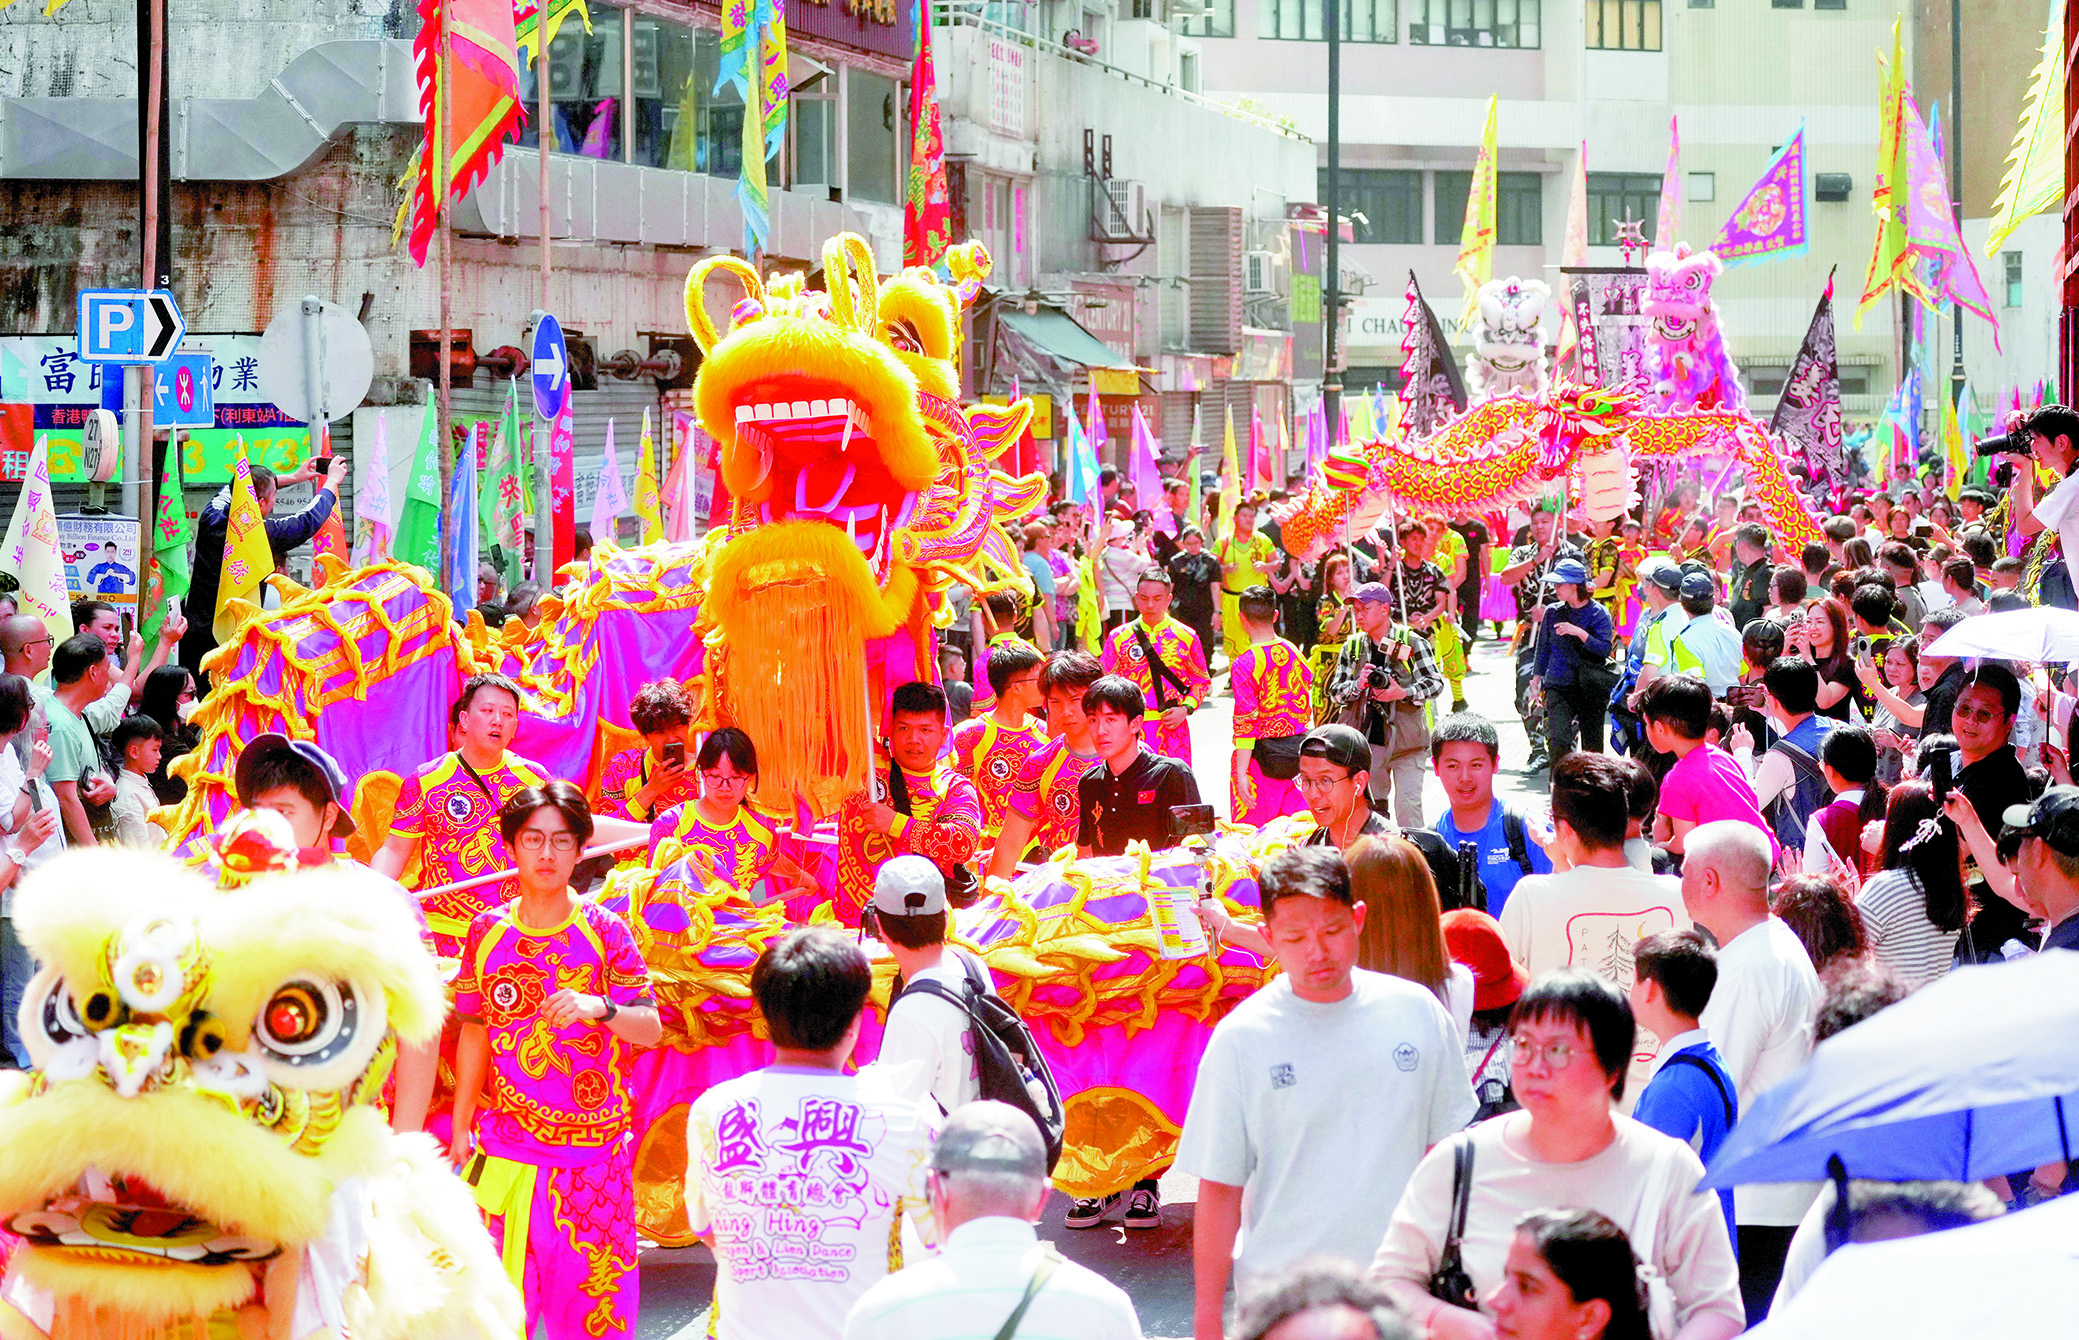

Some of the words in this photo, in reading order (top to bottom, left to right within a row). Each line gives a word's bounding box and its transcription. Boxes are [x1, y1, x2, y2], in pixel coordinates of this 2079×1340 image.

[160, 275, 169, 286] 3
[99, 304, 135, 349] P
[88, 419, 98, 441] 27
[610, 971, 638, 985] DRAGON
[713, 1098, 869, 1174] 盛興
[769, 1212, 819, 1240] Hing
[776, 1243, 804, 1256] Lion
[813, 1244, 852, 1257] Dance
[732, 1264, 765, 1278] Sport
[774, 1263, 845, 1279] Association
